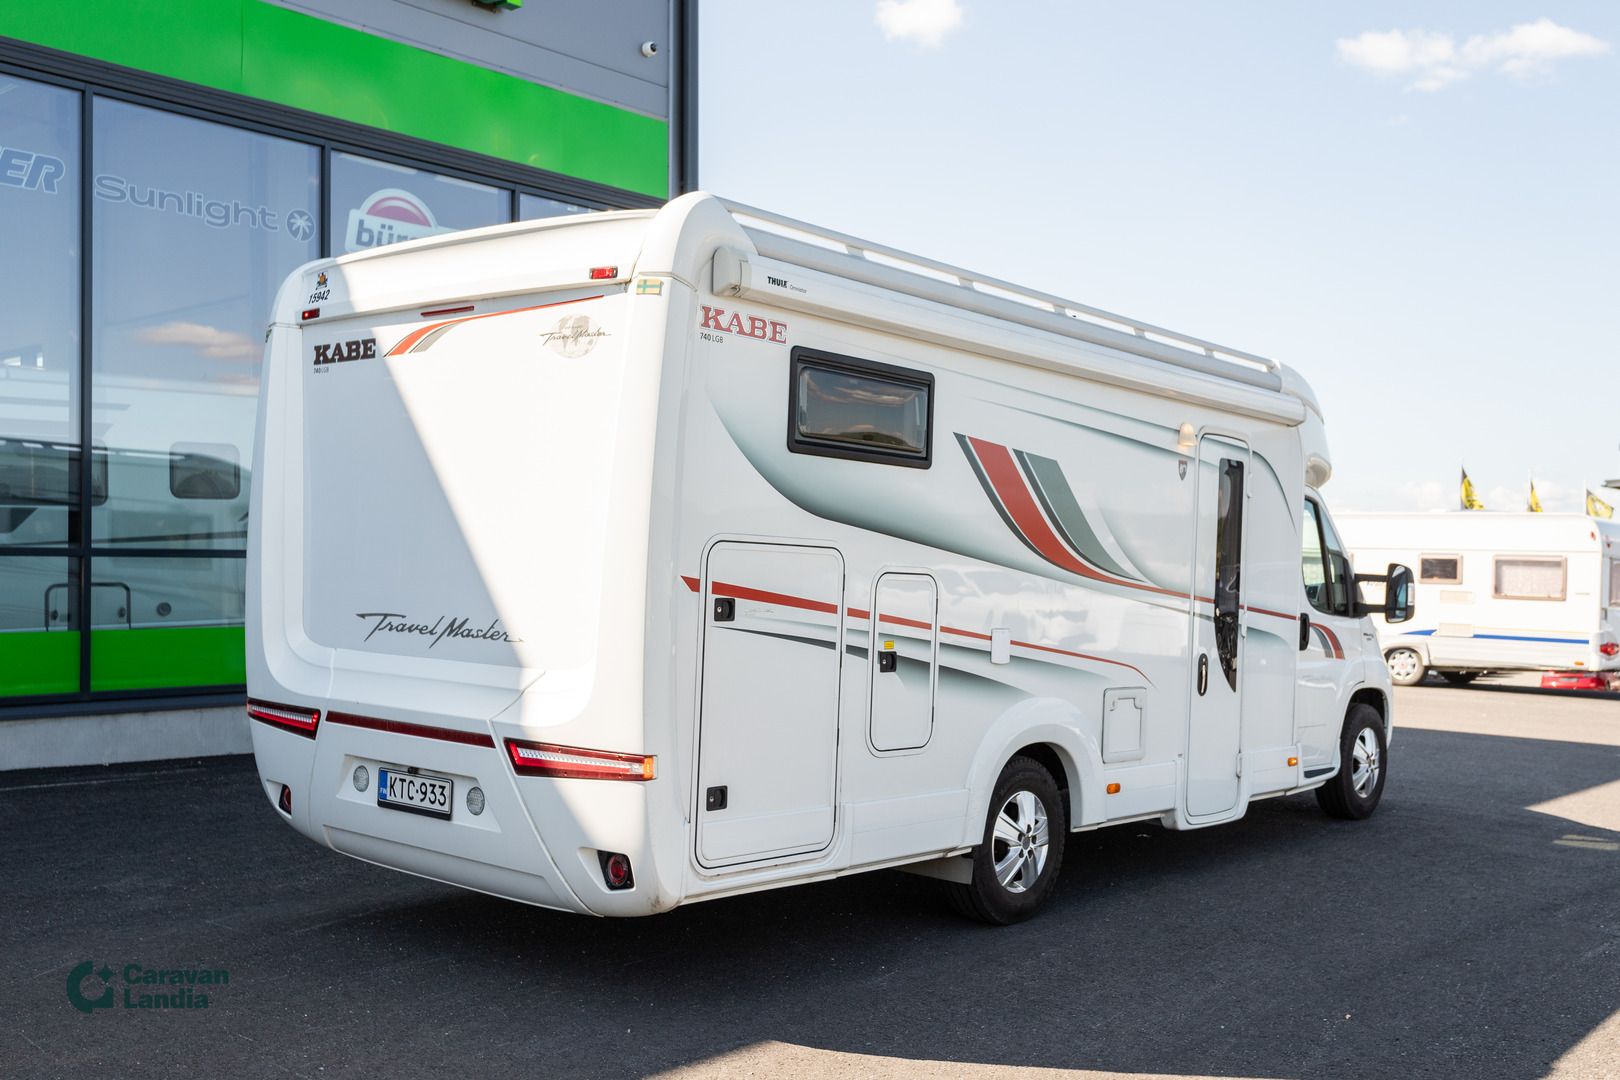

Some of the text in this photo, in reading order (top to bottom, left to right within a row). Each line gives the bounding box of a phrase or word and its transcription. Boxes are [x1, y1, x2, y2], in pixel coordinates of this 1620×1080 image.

[0, 147, 65, 194] ER
[95, 174, 279, 231] Sunlight
[308, 289, 331, 304] 15942
[767, 275, 788, 289] THULE
[700, 332, 711, 342] 740
[701, 304, 788, 345] KABE
[313, 338, 376, 365] KABE
[356, 613, 523, 649] Travel Master
[389, 776, 447, 807] KTC-933
